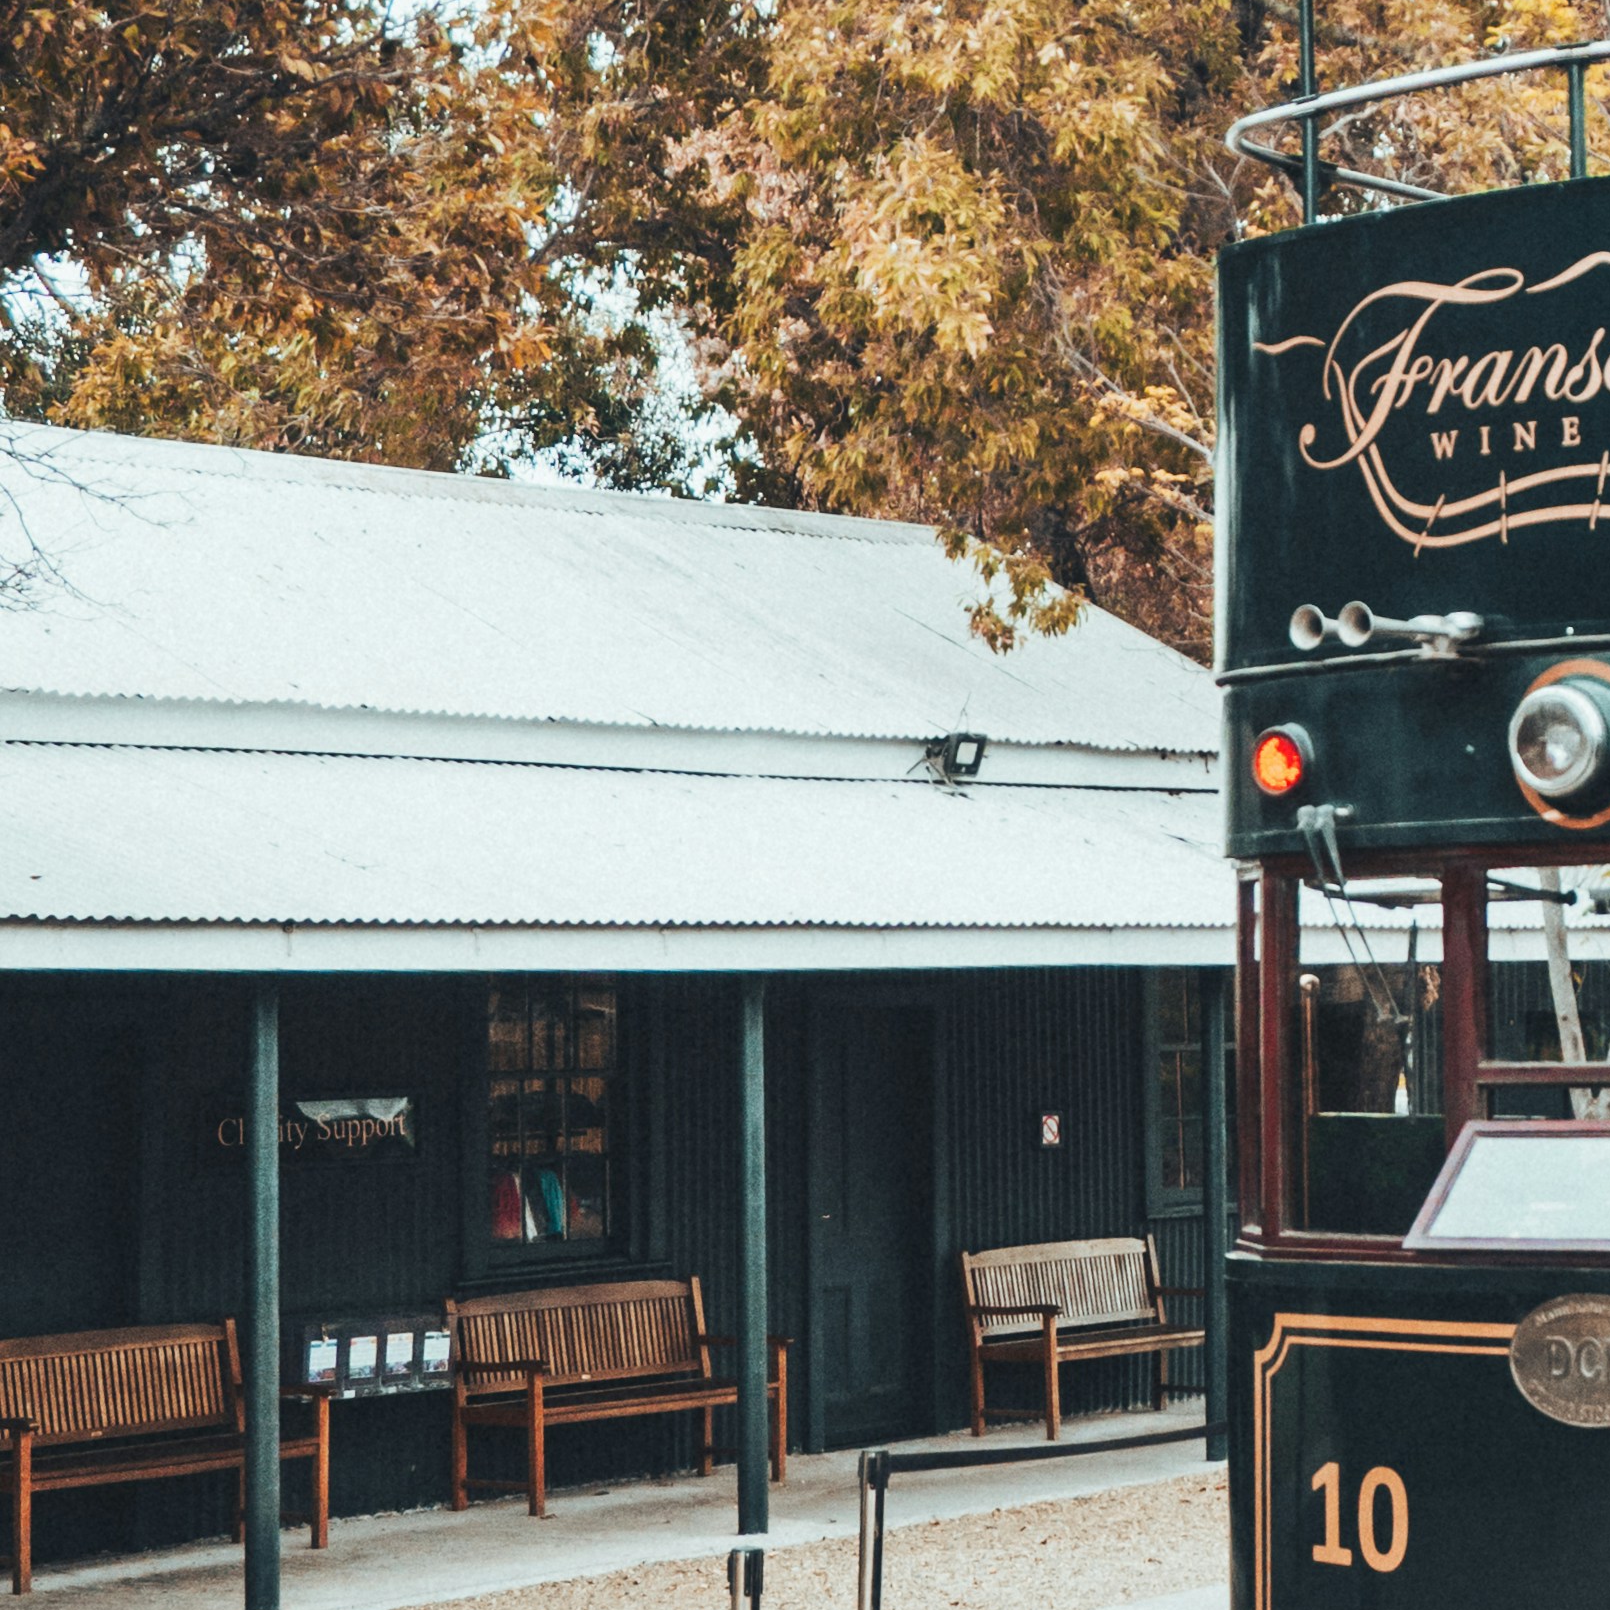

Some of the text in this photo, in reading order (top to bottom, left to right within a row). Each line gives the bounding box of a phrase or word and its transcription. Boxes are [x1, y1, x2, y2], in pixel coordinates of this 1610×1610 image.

[1431, 416, 1583, 461] WINE
[317, 1113, 407, 1148] Support
[1310, 1461, 1410, 1574] 10
